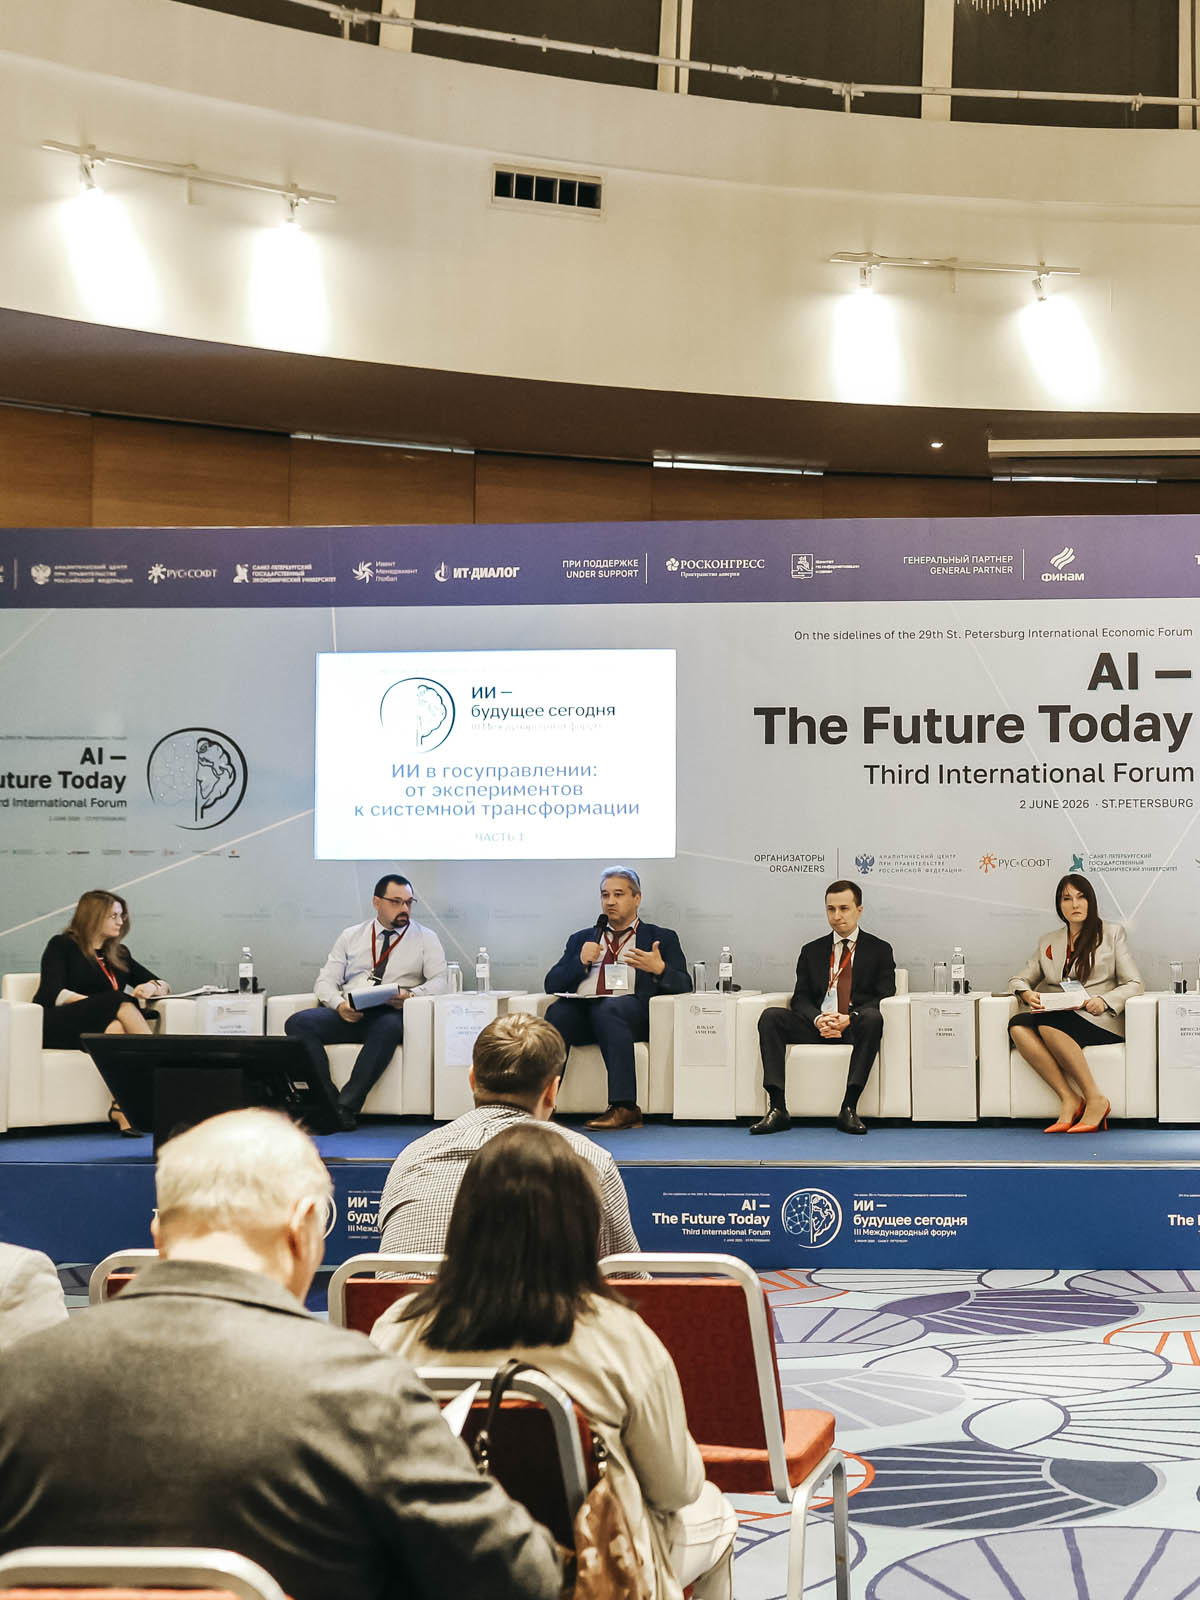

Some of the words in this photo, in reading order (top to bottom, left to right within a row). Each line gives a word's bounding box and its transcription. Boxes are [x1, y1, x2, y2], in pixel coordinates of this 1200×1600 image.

[563, 560, 580, 568] ПРИ
[584, 559, 638, 568] ПОДДЕРЖКЕ
[680, 559, 765, 569] РОСКОНГРЕСС
[903, 555, 969, 564] ГЕНЕРАЛЬНЫЙ
[566, 570, 596, 578] UNDER
[598, 570, 638, 578] SUPPORT
[973, 566, 1013, 574] PARTNER
[794, 631, 810, 640] On
[812, 631, 830, 640] the
[833, 630, 881, 640] sidelines
[884, 629, 896, 639] of
[898, 629, 916, 639] the
[918, 629, 943, 639] 29th
[947, 629, 961, 639] St.
[965, 629, 1025, 640] Petersburg
[1028, 628, 1098, 639] International
[1102, 628, 1155, 638] Economic
[1158, 627, 1192, 637] Forum
[1087, 652, 1138, 690] AI
[472, 687, 496, 699] ИИ
[471, 705, 544, 720] будущее
[548, 704, 615, 718] сегодня
[754, 706, 848, 744] The
[863, 706, 1024, 744] Future
[1038, 704, 1192, 752] Today
[80, 747, 103, 765] AI
[392, 765, 420, 778] ИИ
[427, 767, 435, 777] в
[443, 764, 597, 781] госуправлении:
[864, 764, 929, 785] Third
[939, 764, 1104, 784] International
[1114, 763, 1194, 783] Forum
[58, 771, 126, 793] Today
[406, 785, 425, 797] от
[433, 784, 583, 800] экспериментов
[13, 798, 87, 808] International
[91, 798, 127, 808] Forum
[1020, 799, 1026, 809] 2
[1029, 799, 1059, 809] JUNE
[1062, 799, 1089, 809] 2026
[1102, 798, 1193, 808] ST.PETERSBURG
[355, 807, 363, 816] к
[371, 801, 475, 817] системной
[481, 801, 640, 819] трансформации
[475, 832, 514, 842] ЧАСТЬ
[348, 1197, 367, 1207] ИИ
[347, 1210, 380, 1223] буду
[652, 1213, 678, 1224] The
[682, 1213, 725, 1224] Future
[728, 1213, 769, 1227] Today
[854, 1214, 911, 1227] будущее
[914, 1215, 967, 1226] сегодня
[1168, 1215, 1194, 1226] The
